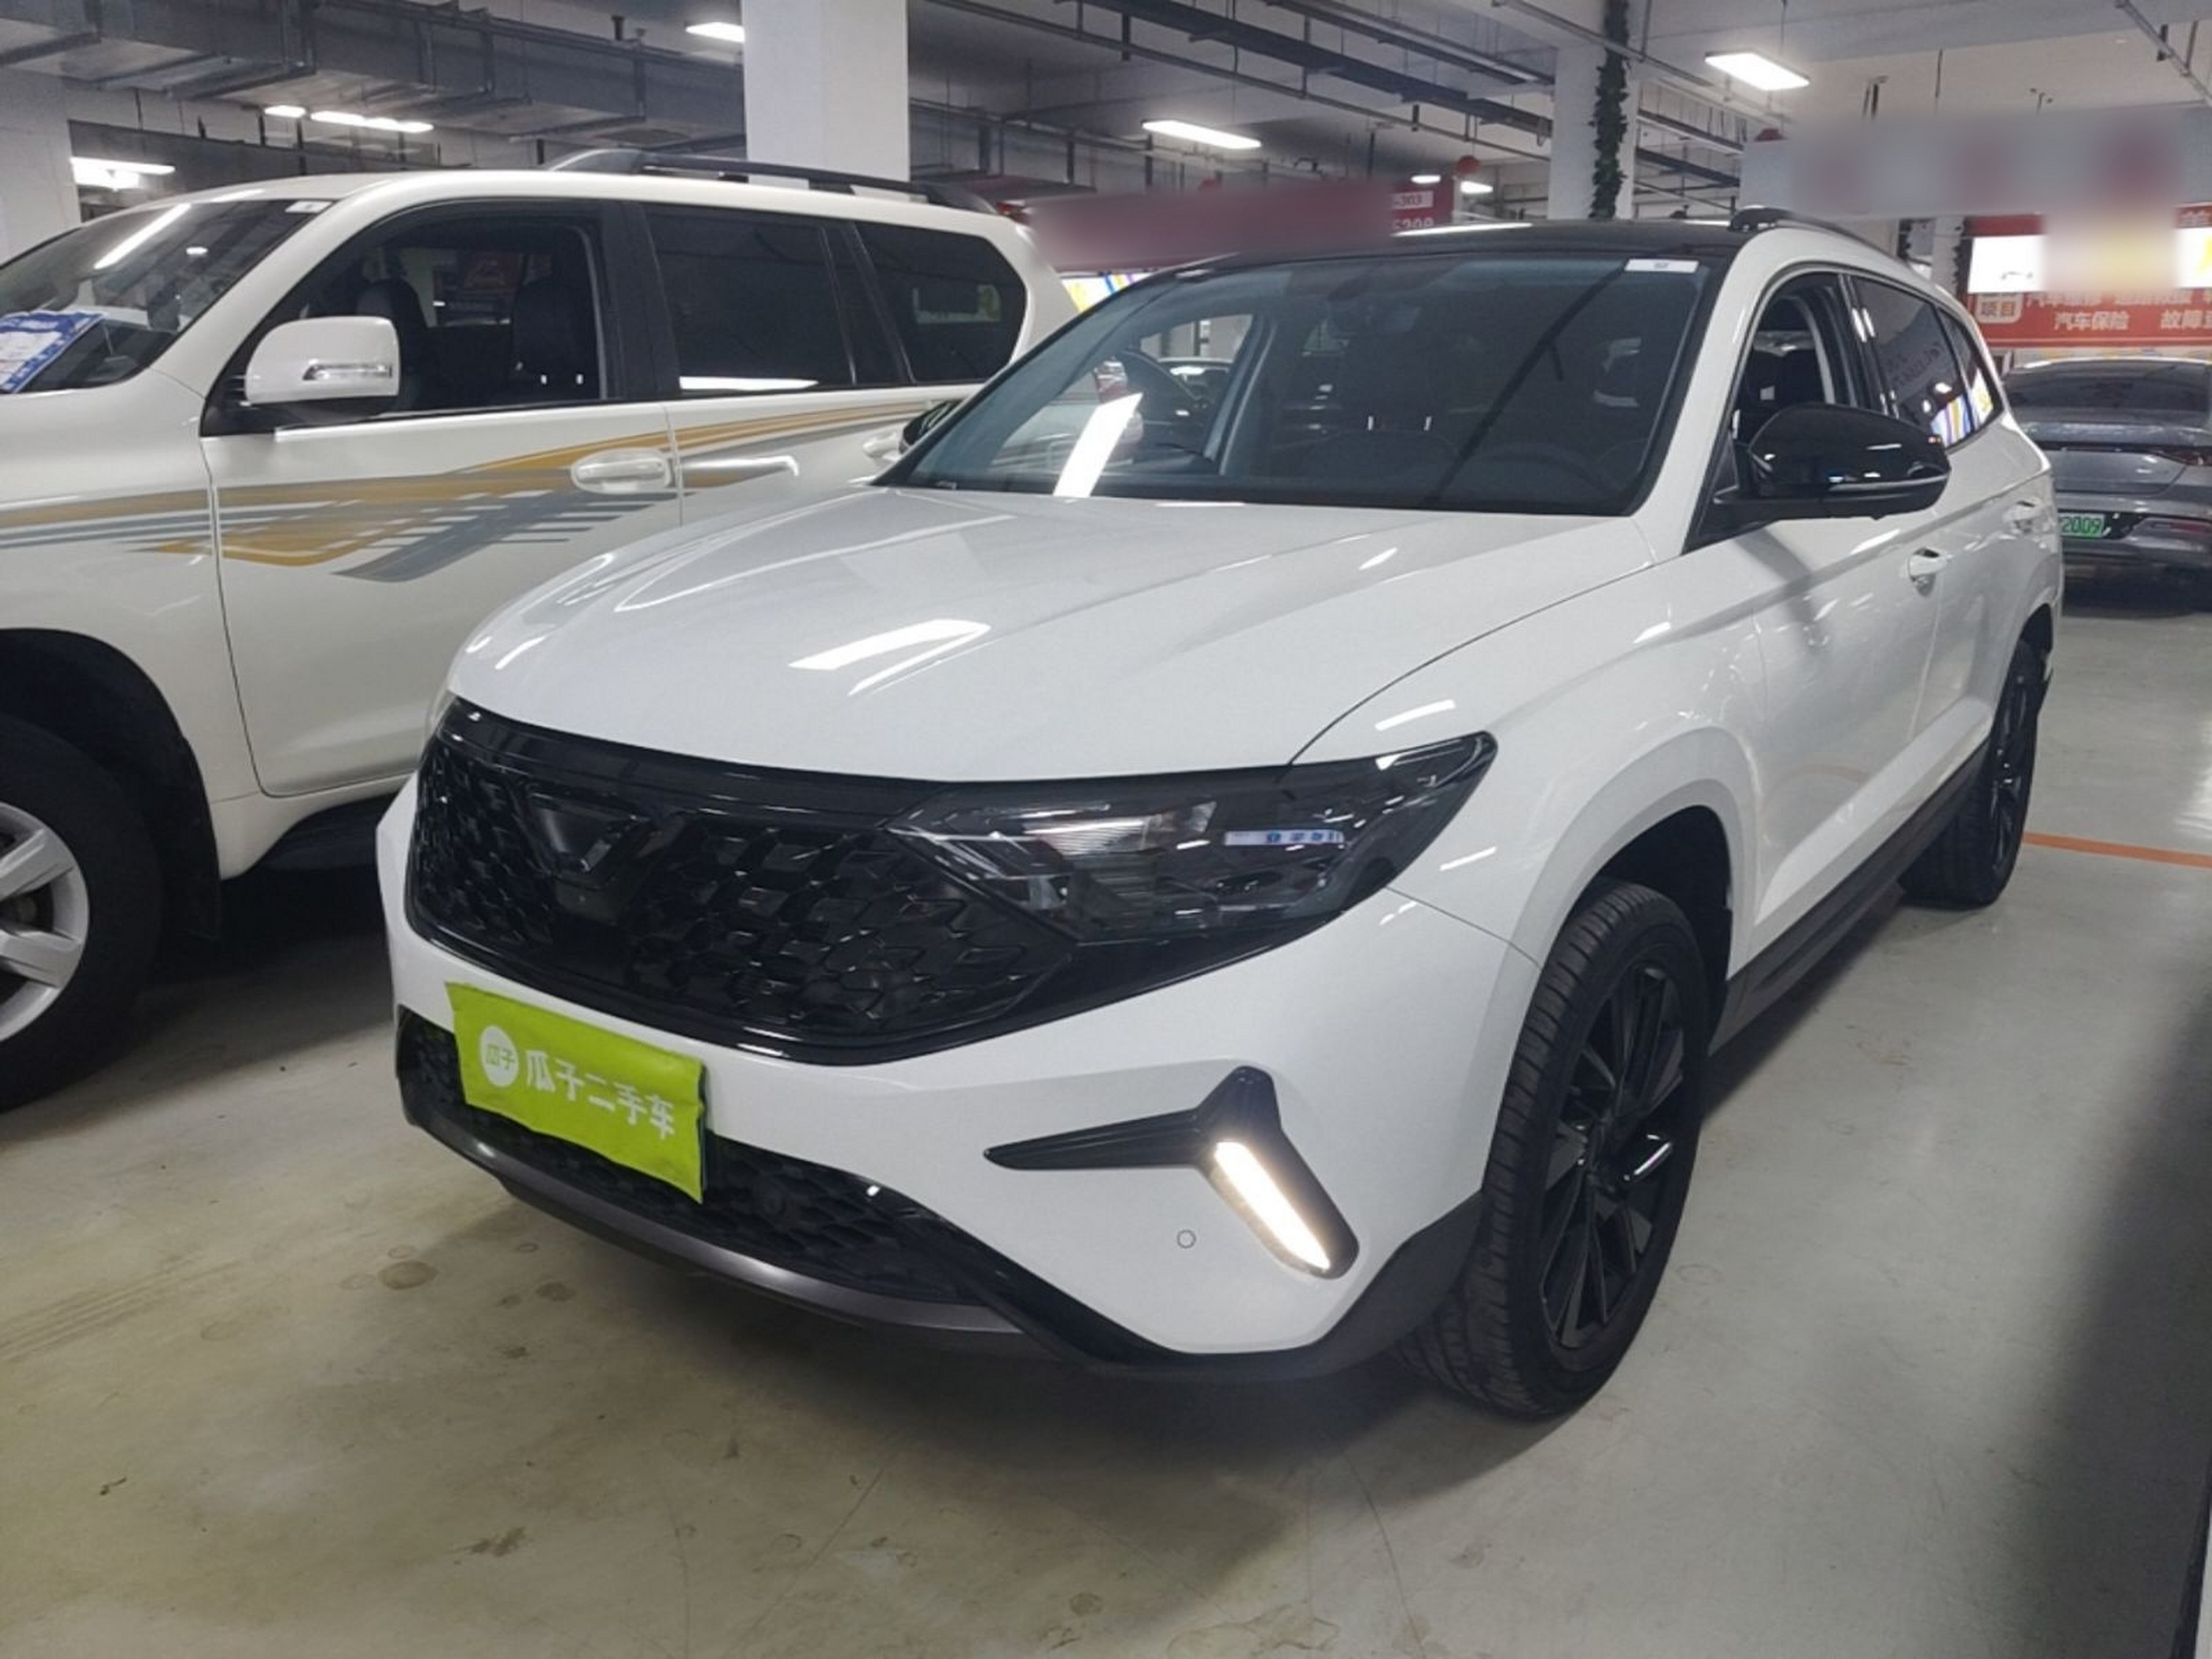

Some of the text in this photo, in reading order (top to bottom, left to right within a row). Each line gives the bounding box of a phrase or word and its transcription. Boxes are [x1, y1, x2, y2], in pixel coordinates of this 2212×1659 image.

[2054, 310, 2130, 331] 汽车保险
[2058, 517, 2101, 534] 2009
[525, 1050, 675, 1139] 瓜子二手车
